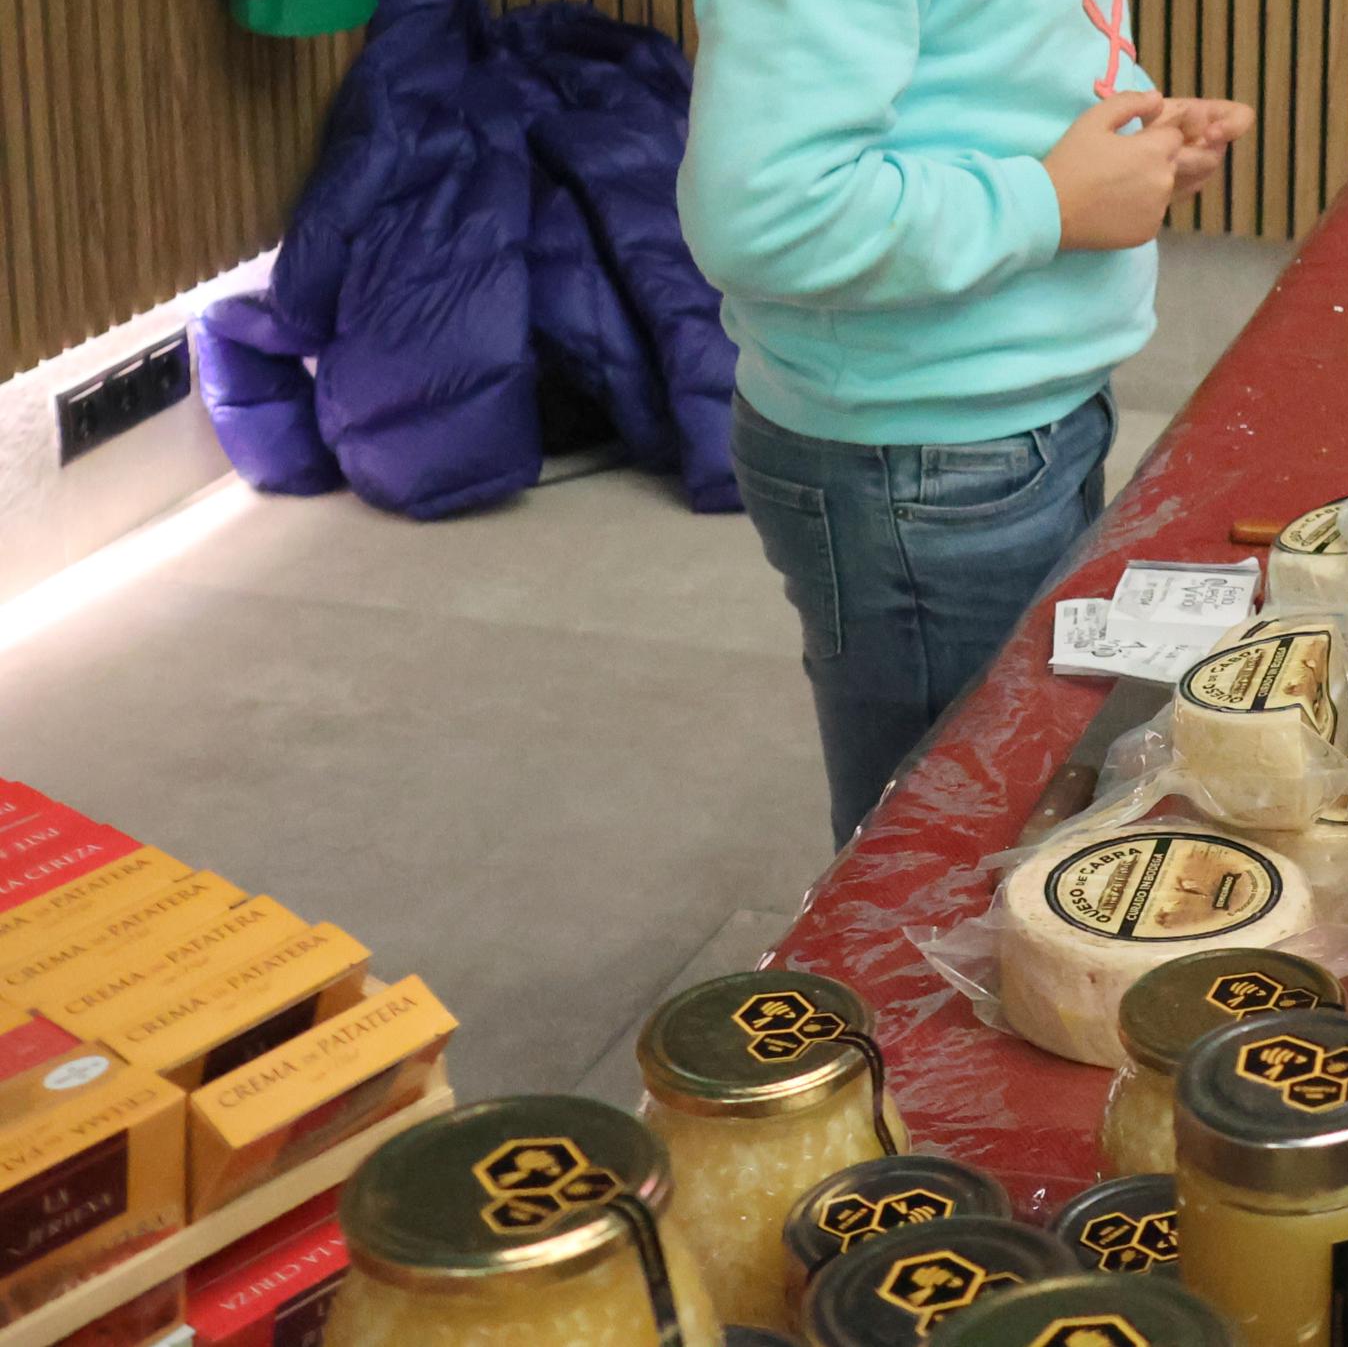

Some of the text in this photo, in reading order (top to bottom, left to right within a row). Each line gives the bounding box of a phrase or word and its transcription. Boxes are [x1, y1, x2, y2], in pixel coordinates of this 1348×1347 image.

[24, 843, 104, 881] CEREZA
[1080, 847, 1143, 876] CABRA
[1075, 874, 1088, 887] DE
[1069, 888, 1112, 923] QUESO
[1125, 889, 1149, 922] CURADO
[63, 909, 268, 1015] CREMA PATATERA
[125, 934, 329, 1044] CREMA PATATERA
[216, 995, 420, 1108] CREMA PATATERA
